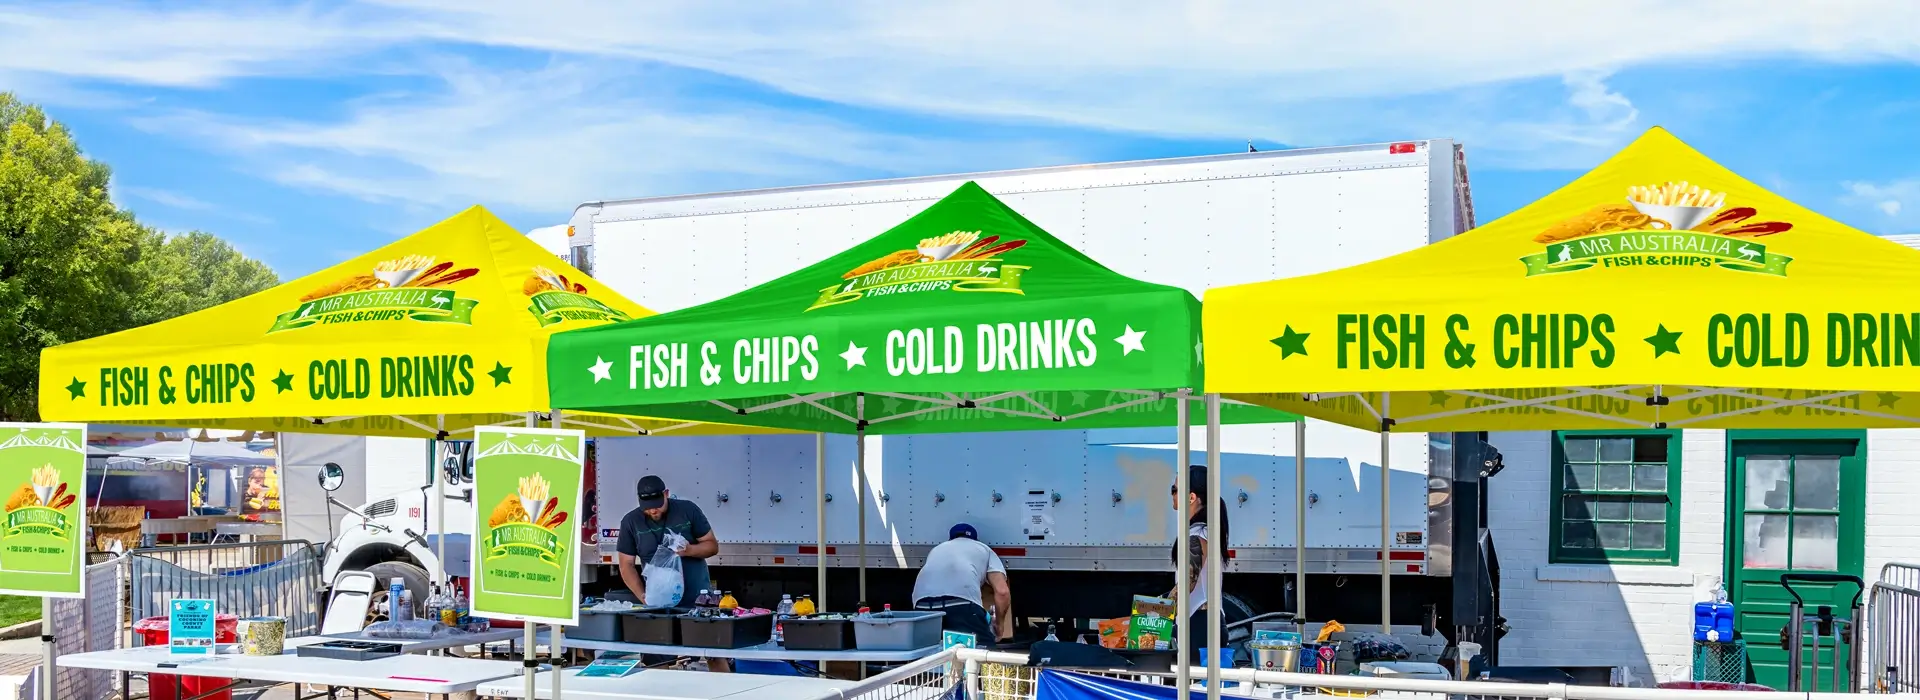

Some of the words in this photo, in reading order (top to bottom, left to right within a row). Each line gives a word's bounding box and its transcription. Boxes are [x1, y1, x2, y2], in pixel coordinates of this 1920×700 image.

[1579, 238, 1614, 256] MR
[1620, 234, 1731, 255] AUSTRALIA
[862, 271, 886, 287] MR
[887, 261, 973, 283] AUSTRALIA
[319, 297, 341, 313] MR
[345, 290, 427, 308] AUSTRALIA
[885, 325, 964, 376] COLD
[977, 318, 1097, 371] DRINKS
[1338, 314, 1424, 369] FISH
[1444, 314, 1475, 368] &
[1494, 314, 1615, 369] CHIPS
[1708, 313, 1809, 368] COLD
[629, 342, 687, 390] FISH
[700, 345, 722, 385] &
[733, 335, 819, 384] CHIPS
[100, 367, 148, 406] FISH
[158, 365, 176, 404] &
[185, 363, 255, 403] CHIPS
[308, 358, 370, 400] COLD
[381, 354, 475, 398] DRINKS
[27, 509, 58, 525] AUSTRALIA
[408, 507, 421, 518] 1191
[501, 528, 512, 542] MR
[513, 527, 547, 545] AUSTRALIA
[1137, 616, 1167, 629] CRUNCHY
